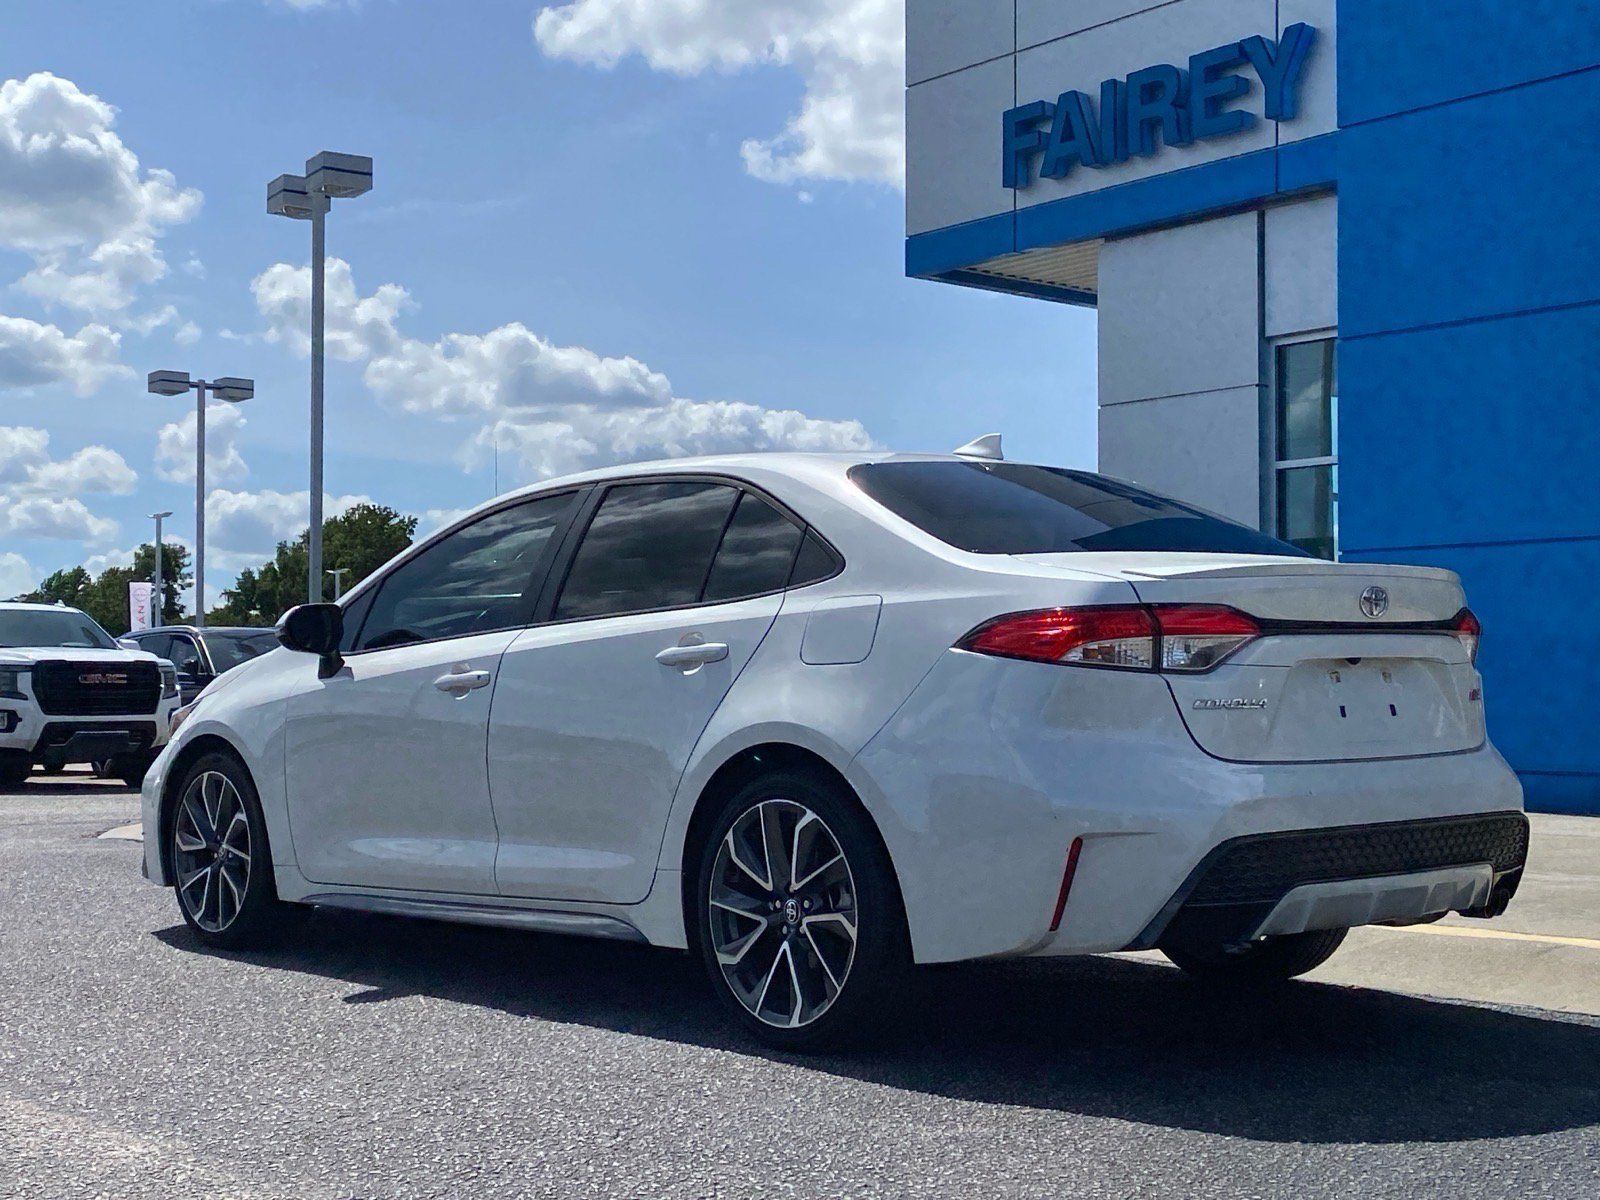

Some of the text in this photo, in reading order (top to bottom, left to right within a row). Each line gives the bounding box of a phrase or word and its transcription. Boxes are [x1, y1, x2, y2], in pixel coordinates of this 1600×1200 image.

[1002, 22, 1316, 189] FAIREY
[78, 673, 128, 684] GMC
[1192, 698, 1268, 710] COROLLA
